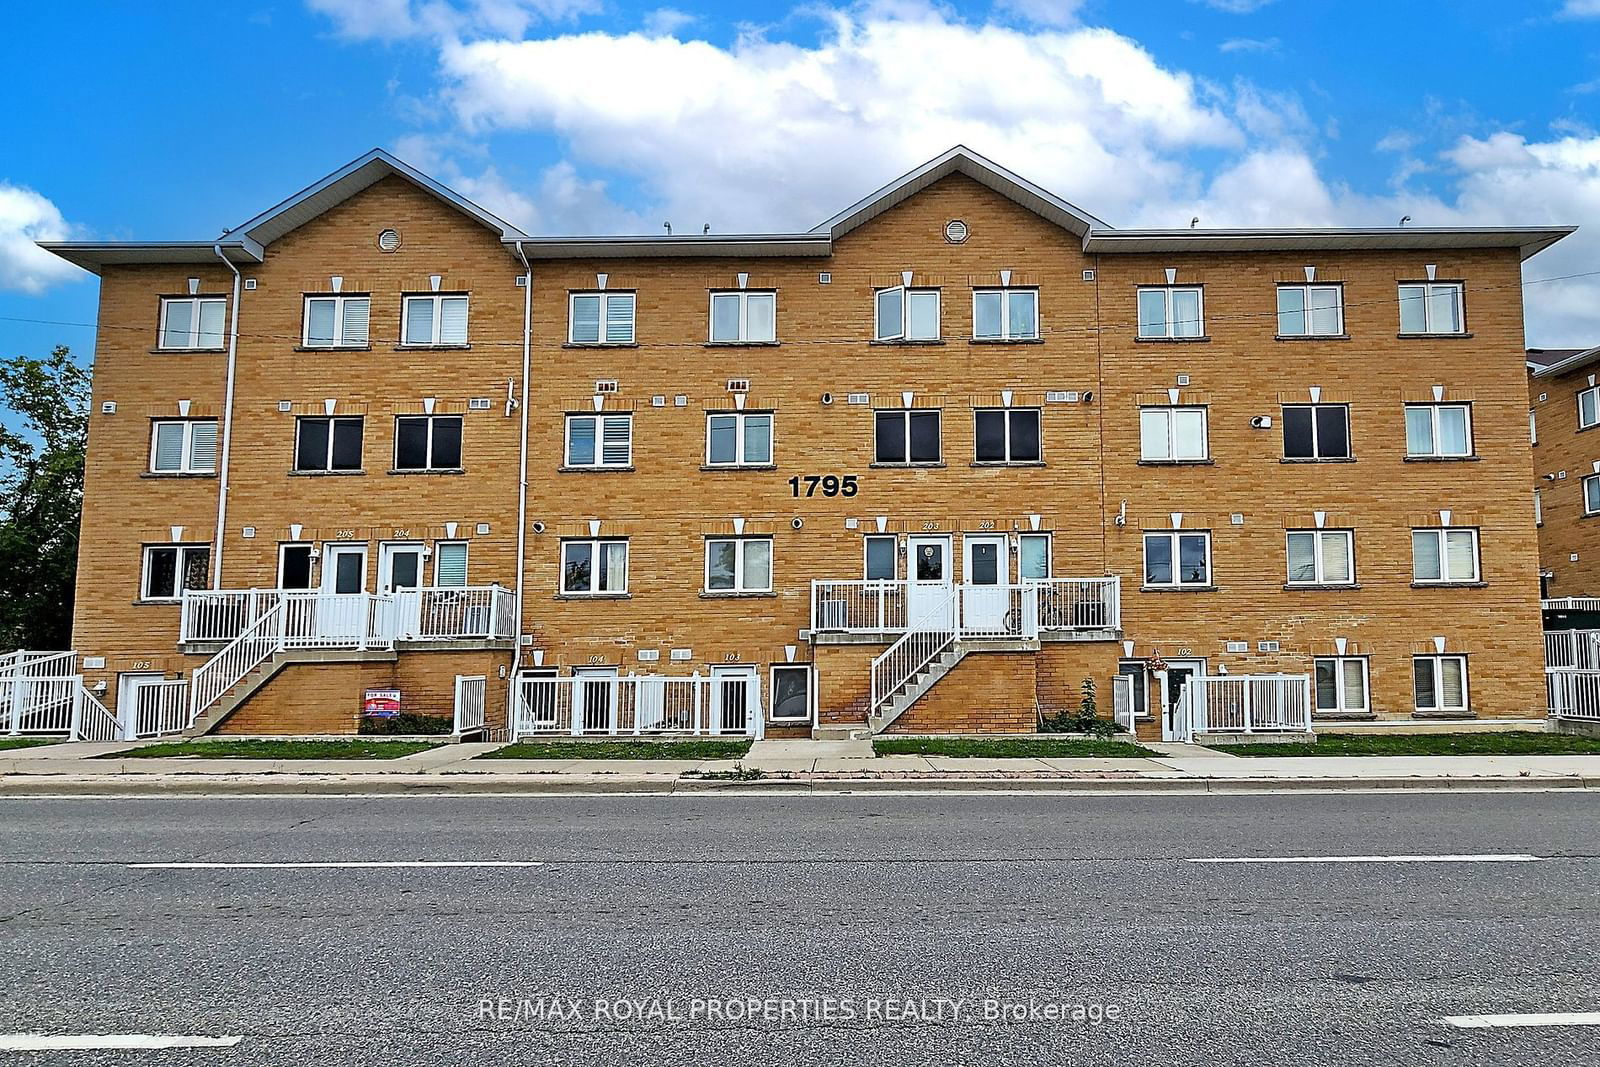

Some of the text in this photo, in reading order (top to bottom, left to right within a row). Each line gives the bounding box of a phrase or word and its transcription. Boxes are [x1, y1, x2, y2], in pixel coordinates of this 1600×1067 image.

[790, 476, 858, 498] 1795
[922, 522, 939, 530] 203
[979, 521, 995, 529] 202
[336, 530, 354, 538] 205
[394, 529, 410, 538] 204
[1177, 648, 1192, 656] 102
[588, 655, 604, 663] 104
[724, 653, 740, 661] 103
[132, 661, 150, 669] 105
